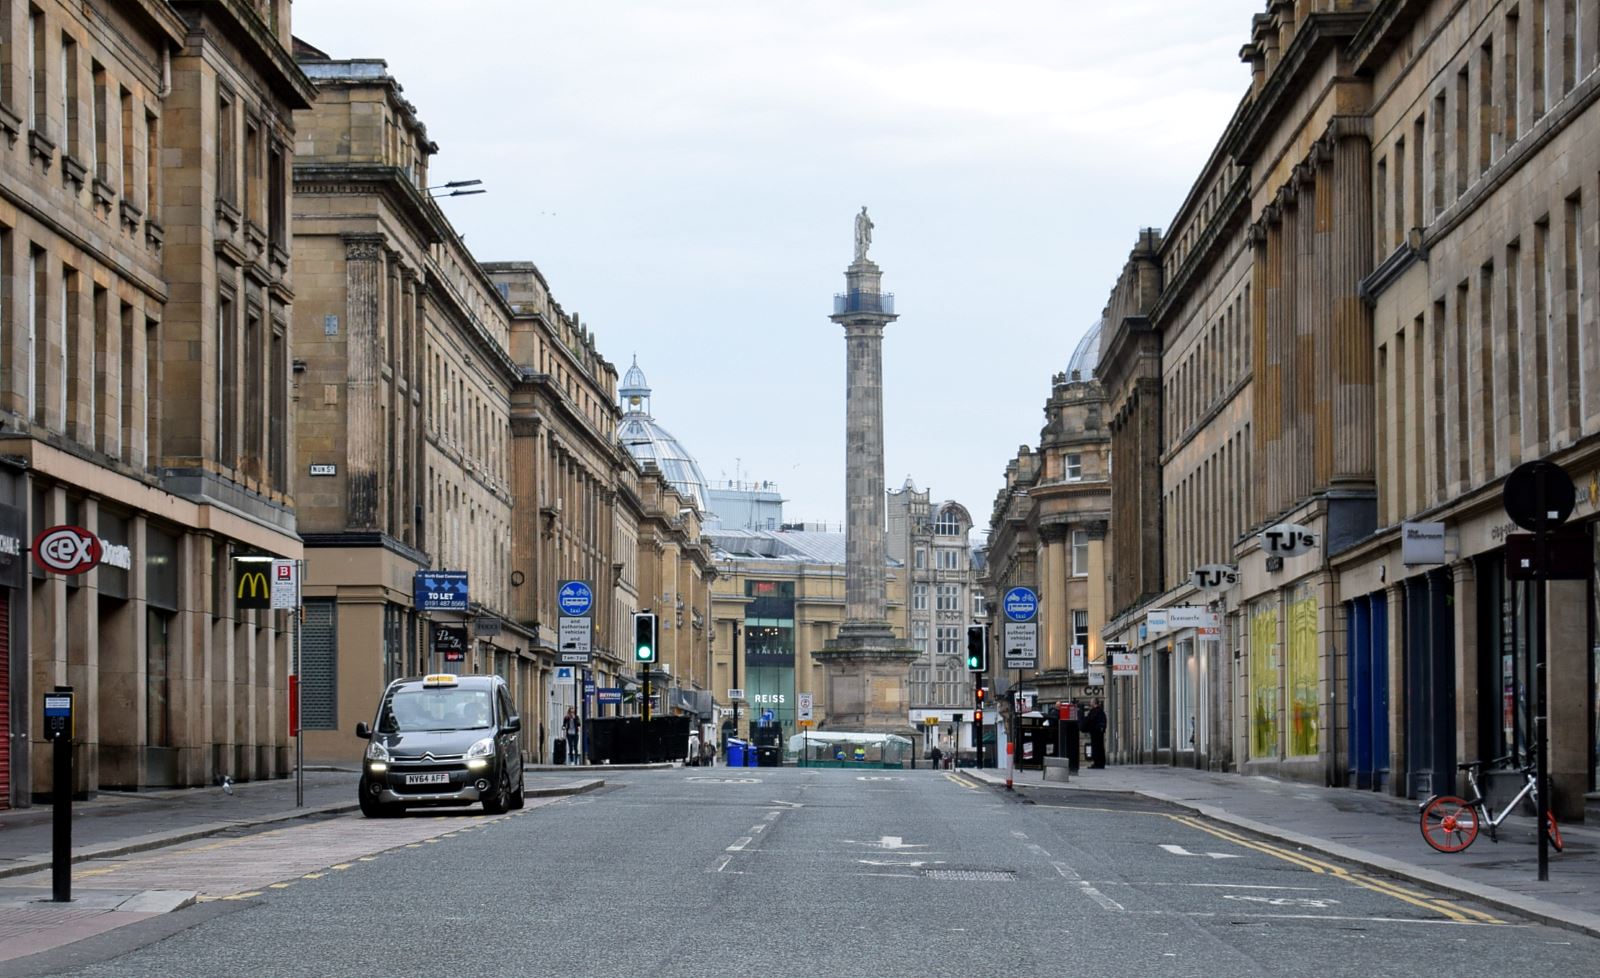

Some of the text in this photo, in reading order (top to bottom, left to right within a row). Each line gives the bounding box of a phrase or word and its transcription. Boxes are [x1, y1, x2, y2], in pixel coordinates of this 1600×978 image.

[1265, 532, 1314, 551] TJ's
[1195, 571, 1236, 587] TJ's
[755, 694, 785, 703] REISS
[409, 773, 446, 783] NV64 AFF
